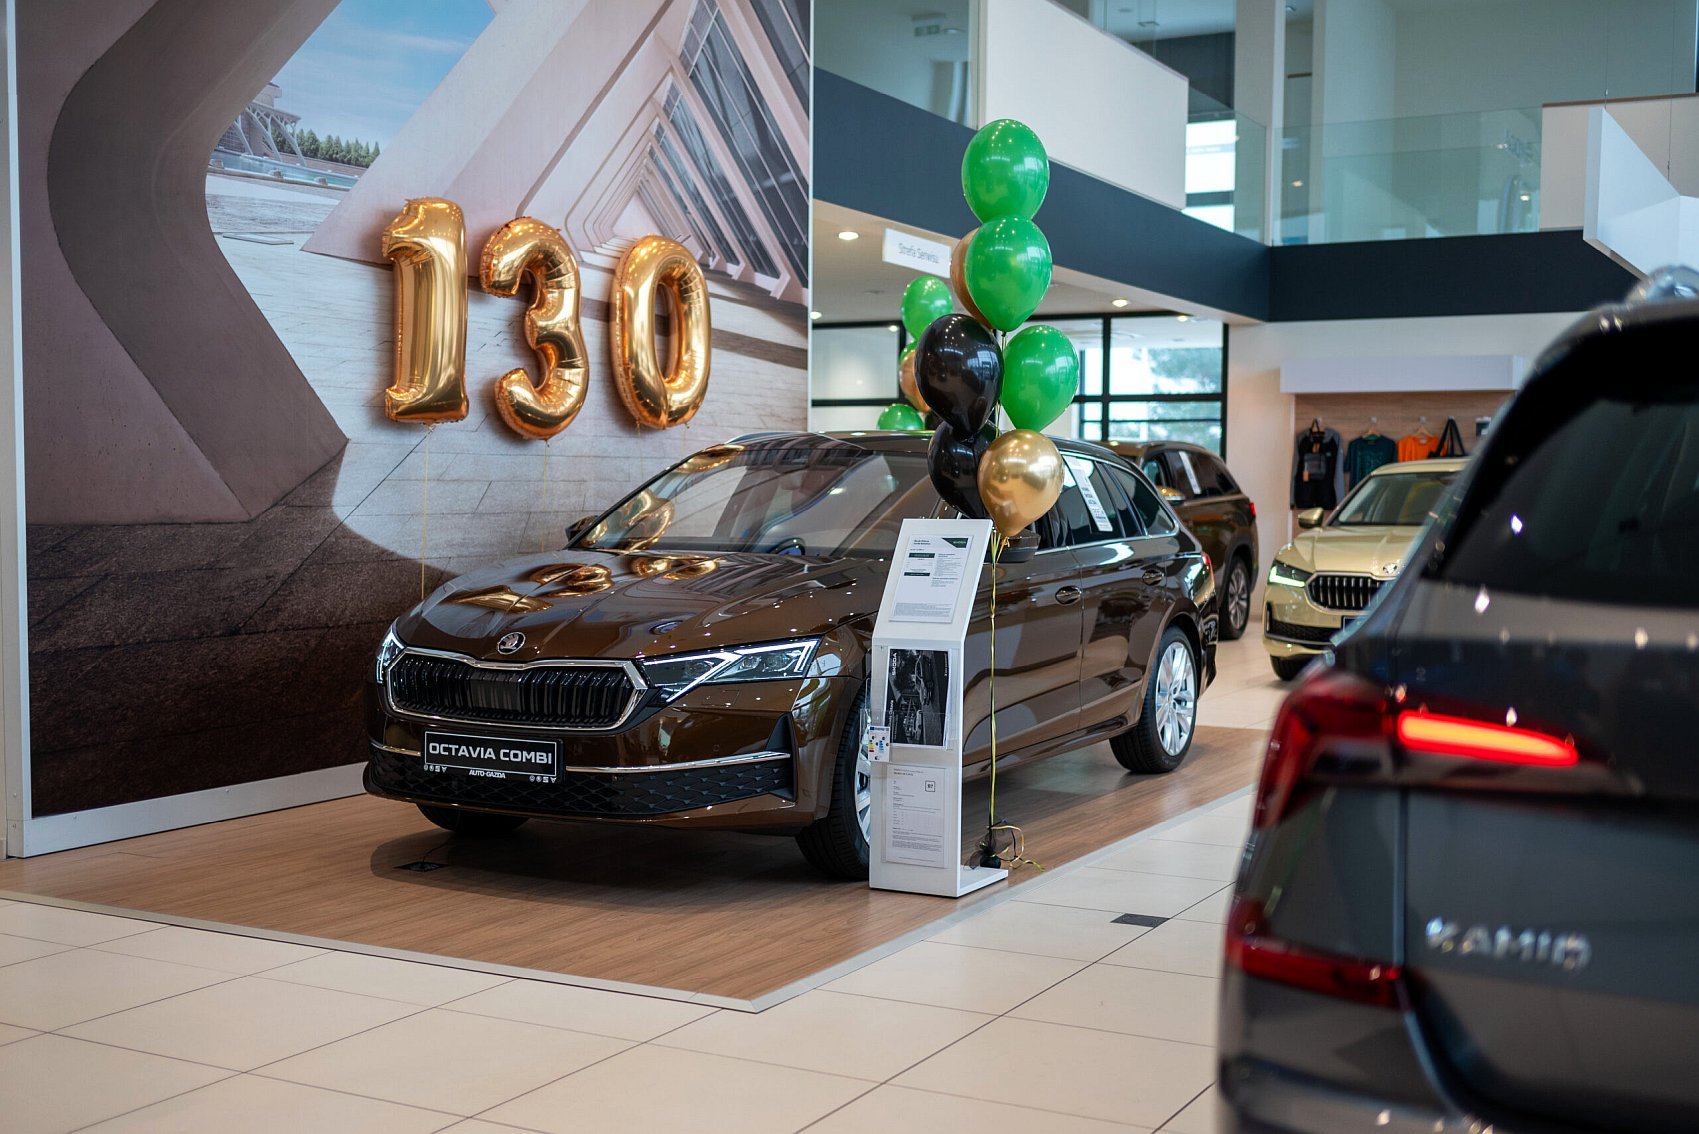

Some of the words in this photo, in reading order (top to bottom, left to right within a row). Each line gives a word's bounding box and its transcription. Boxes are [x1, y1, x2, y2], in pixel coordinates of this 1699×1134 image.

[382, 196, 712, 440] 130
[429, 742, 496, 760] OCTAVIA
[500, 749, 552, 764] COMBI
[469, 769, 506, 779] AUTO-GAZDA
